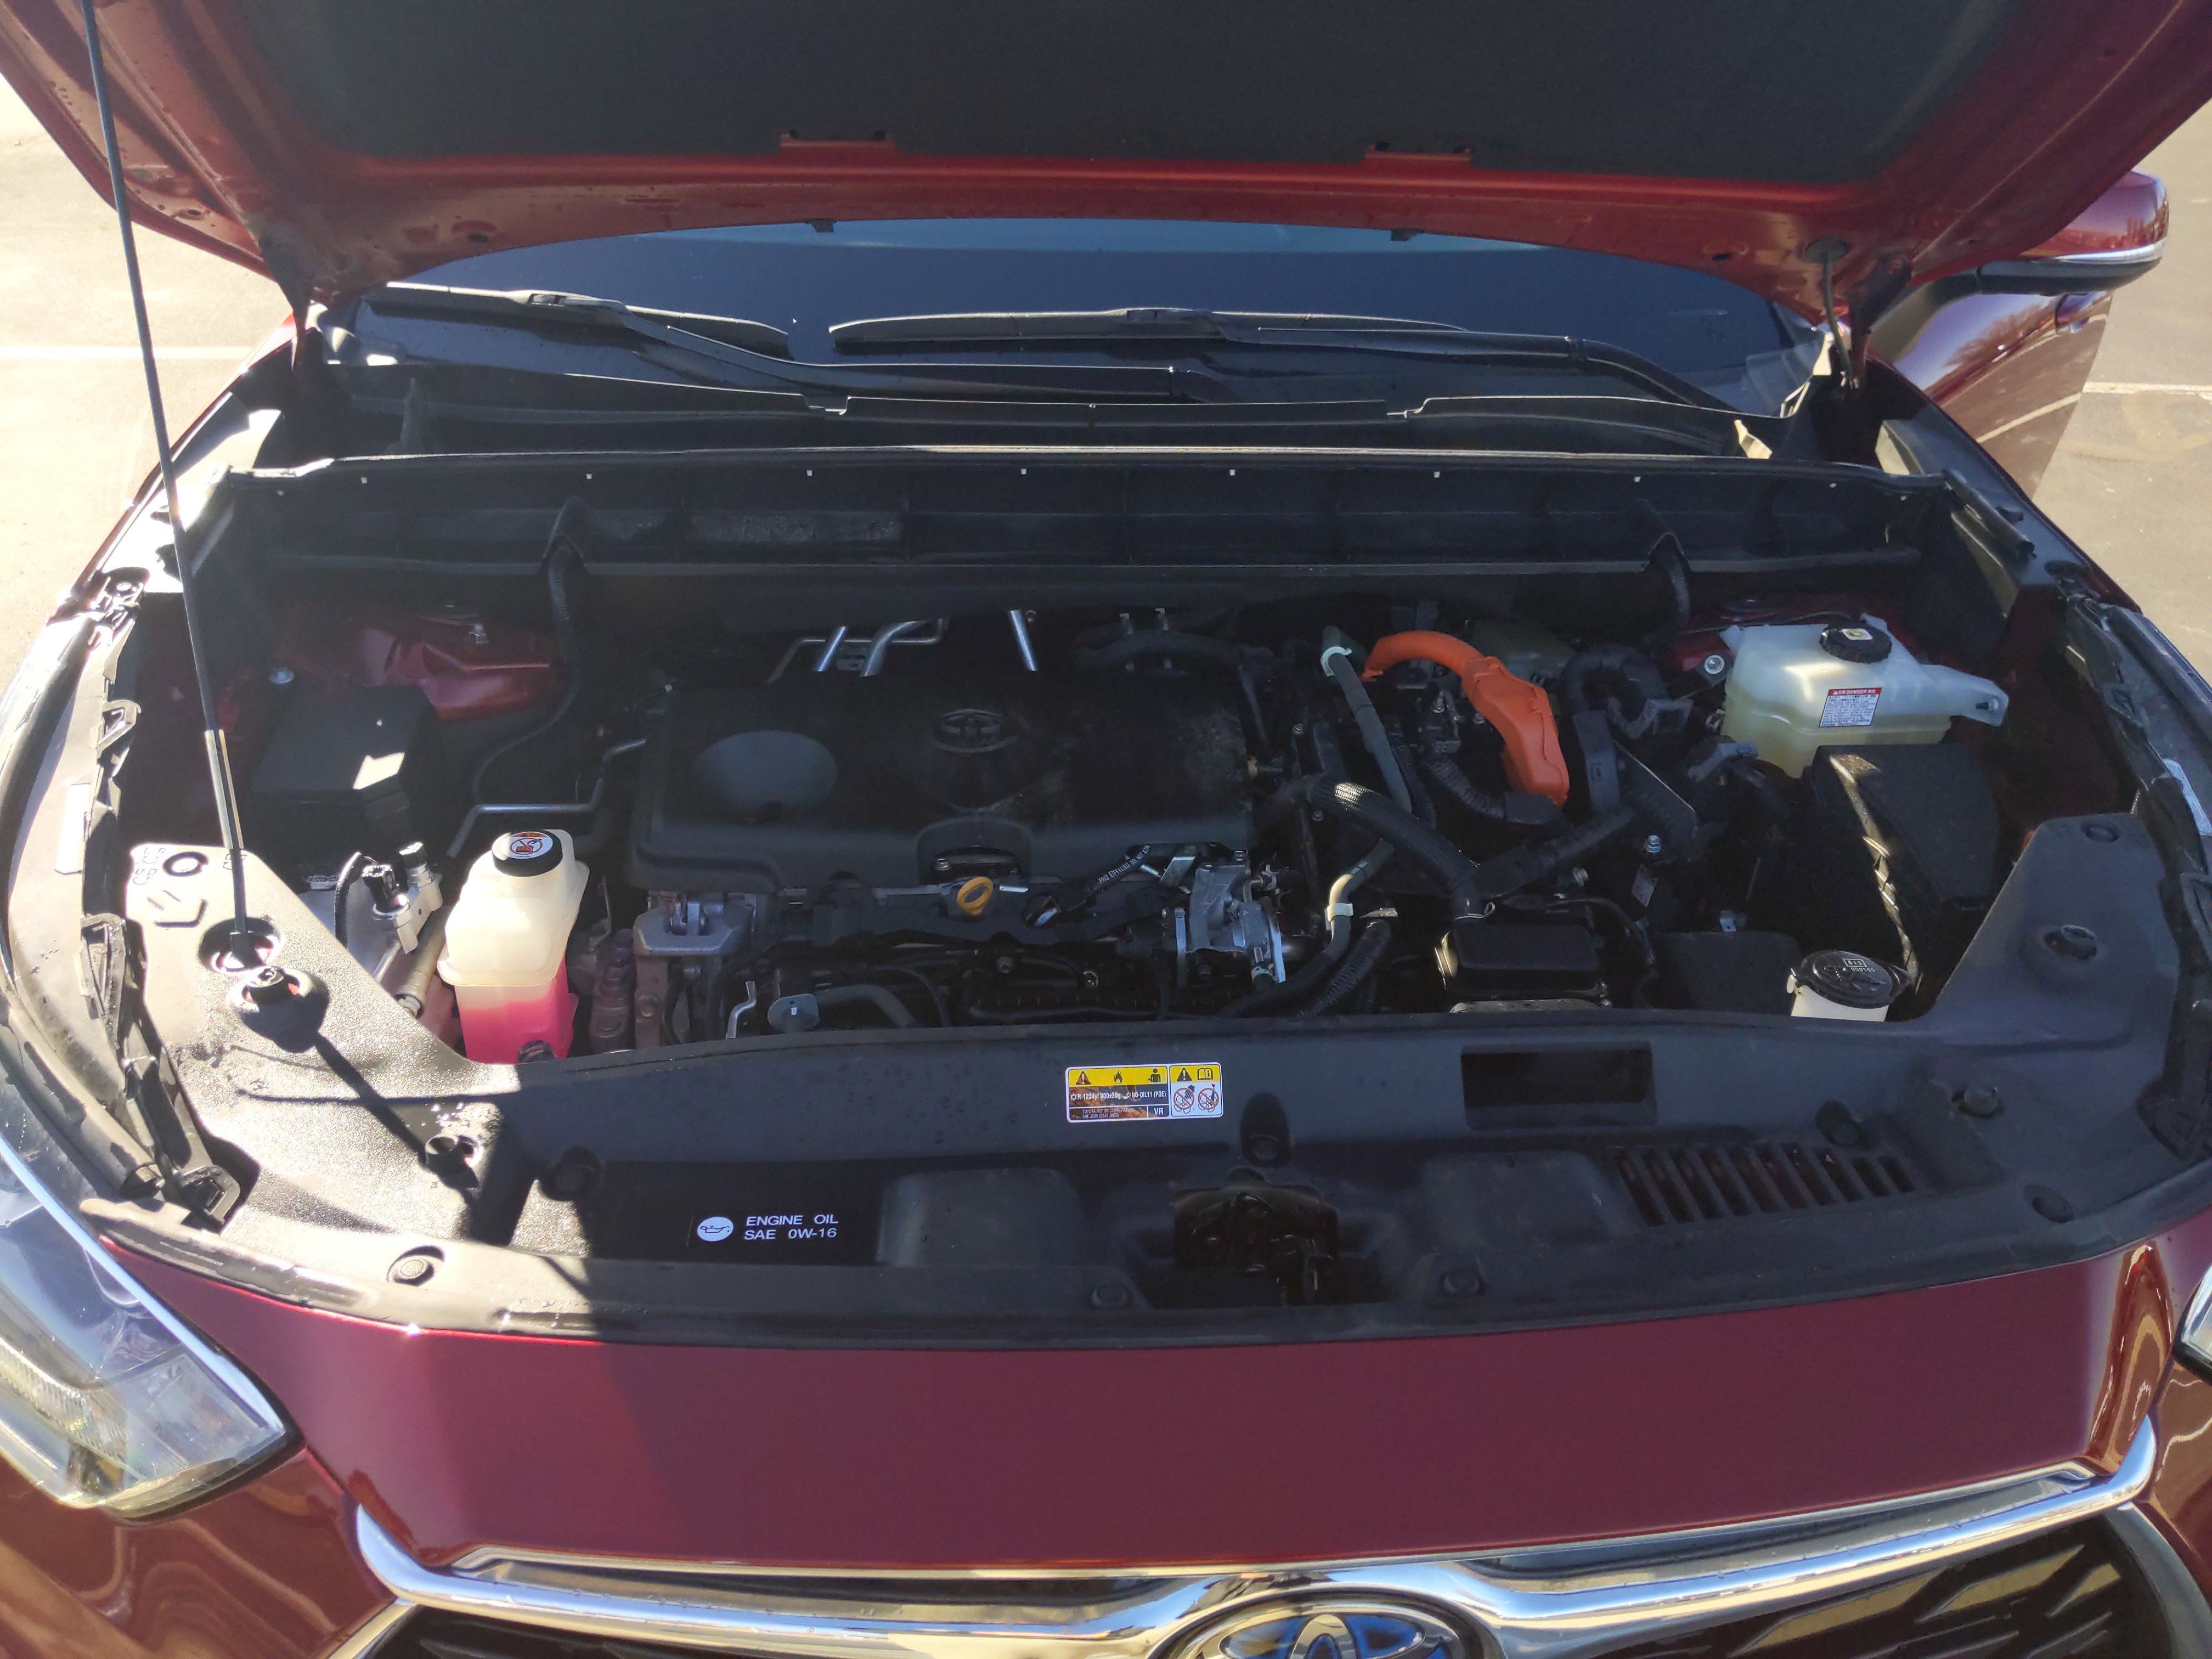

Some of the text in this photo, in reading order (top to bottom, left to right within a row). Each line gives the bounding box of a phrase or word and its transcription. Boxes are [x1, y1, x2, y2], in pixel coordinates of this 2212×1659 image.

[1154, 1091, 1166, 1099] (POE)
[1154, 1107, 1164, 1115] VR
[746, 1214, 839, 1226] ENGINE OIL
[744, 1227, 838, 1240] SAE 0W-16
